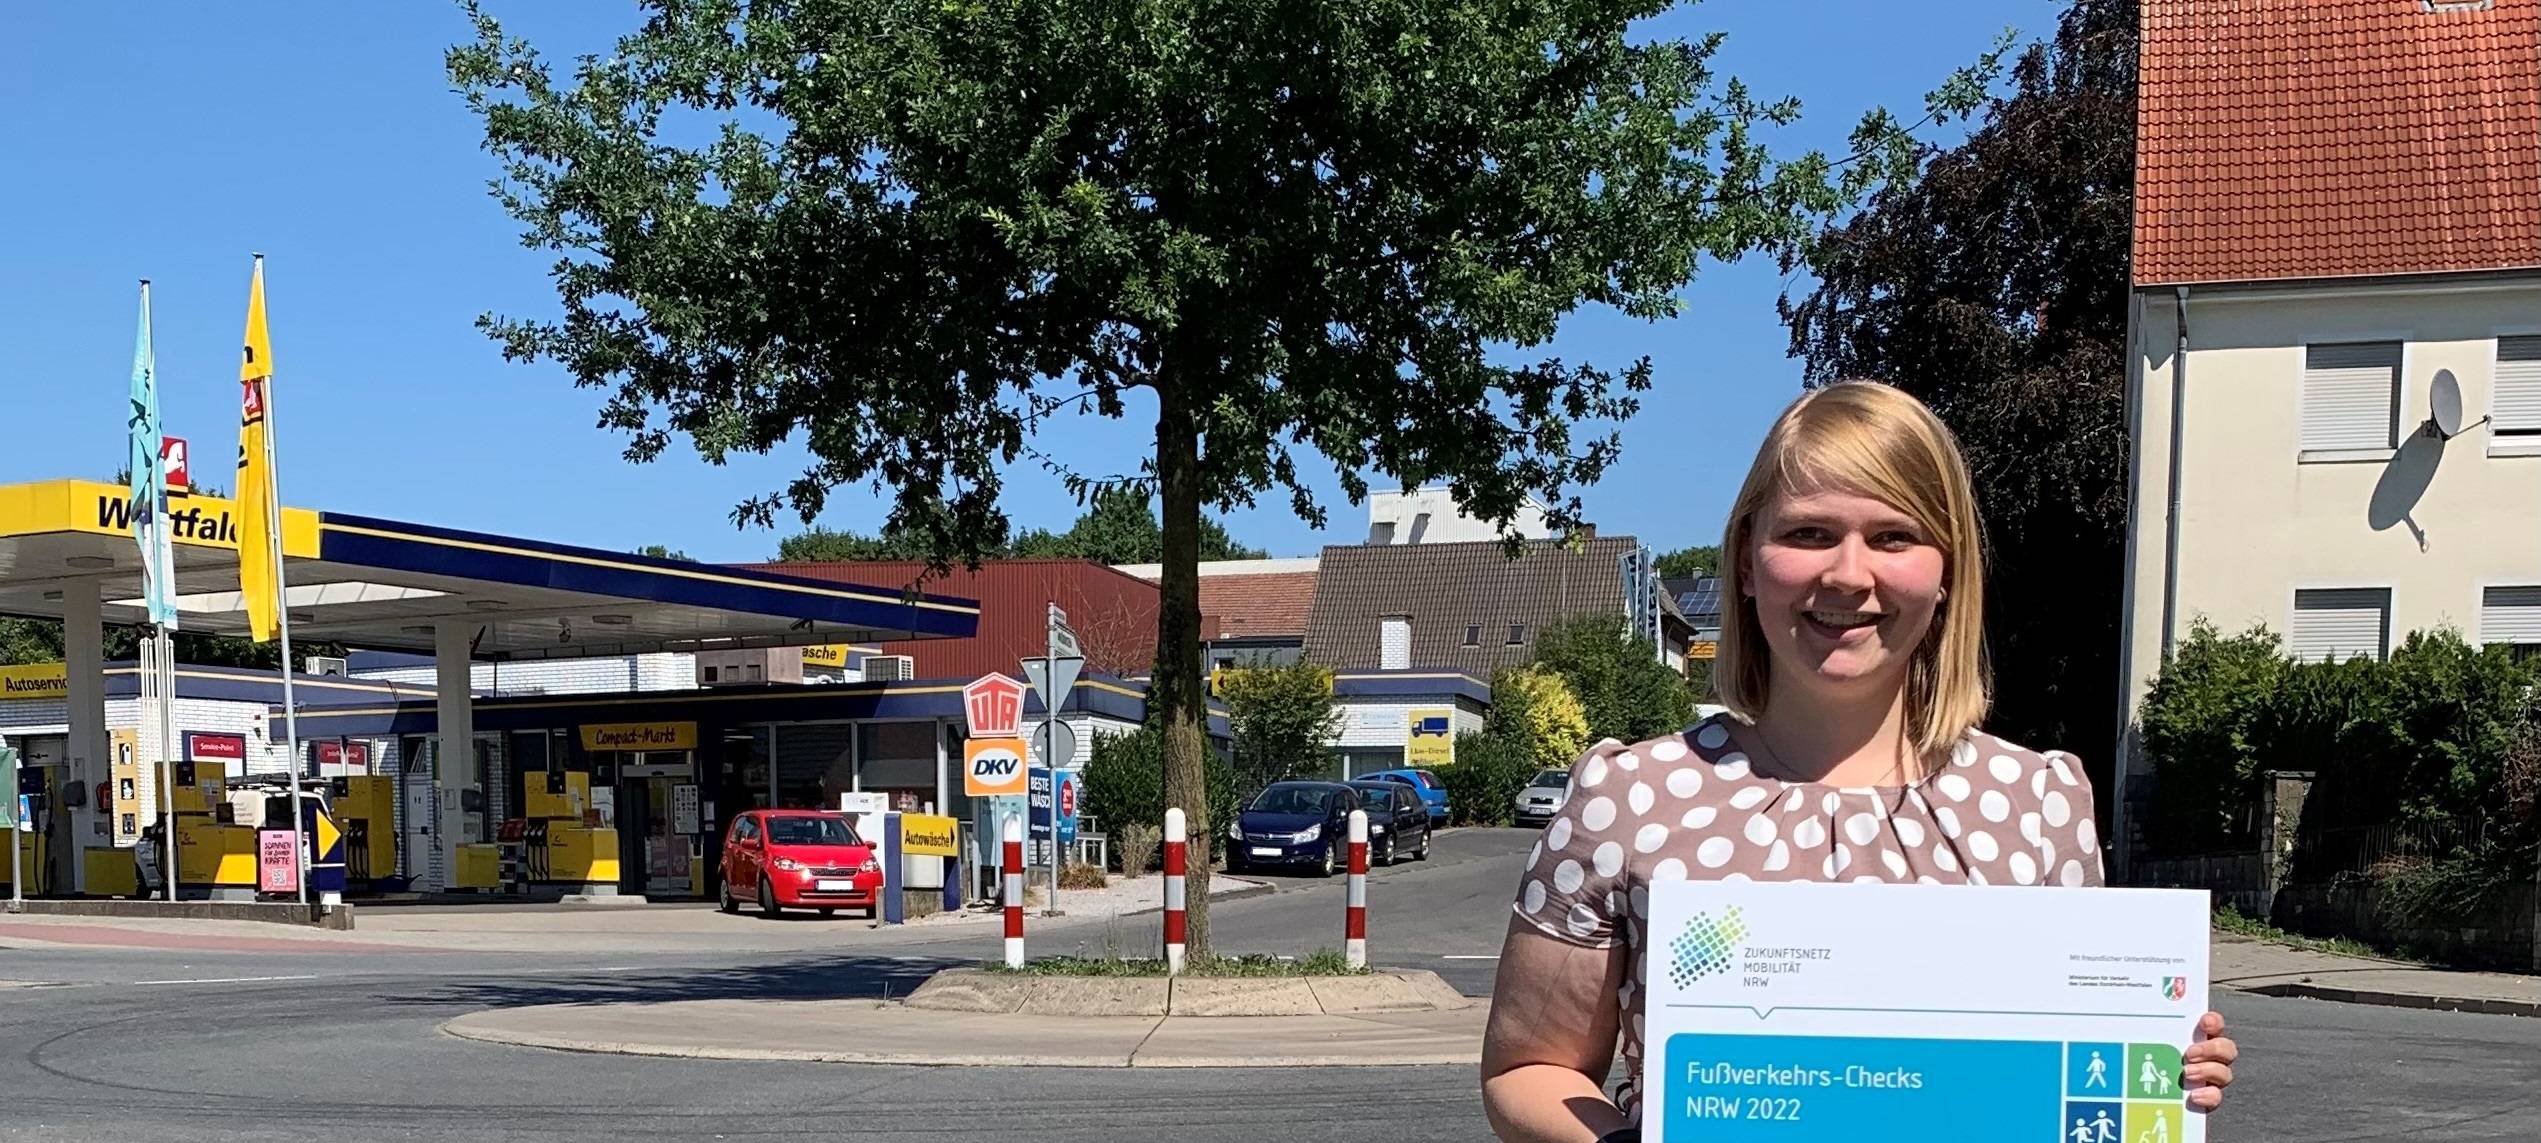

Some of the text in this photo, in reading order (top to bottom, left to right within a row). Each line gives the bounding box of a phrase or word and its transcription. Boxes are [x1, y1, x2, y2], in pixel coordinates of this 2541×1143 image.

[99, 495, 237, 543] Wtfal
[970, 679, 1020, 731] UTA
[596, 726, 676, 748] Compact-Markt
[974, 758, 1018, 776] DKV
[1030, 776, 1050, 792] BESTE
[905, 829, 950, 848] Autowäsche
[1744, 947, 1831, 960] ZUKUNFTSNETZ
[1743, 961, 1801, 974] MOBILITÄT
[1743, 976, 1769, 987] NRW
[1687, 1061, 1923, 1089] Fußverkehrs-Checks
[1686, 1096, 1801, 1121] NRW 2022
